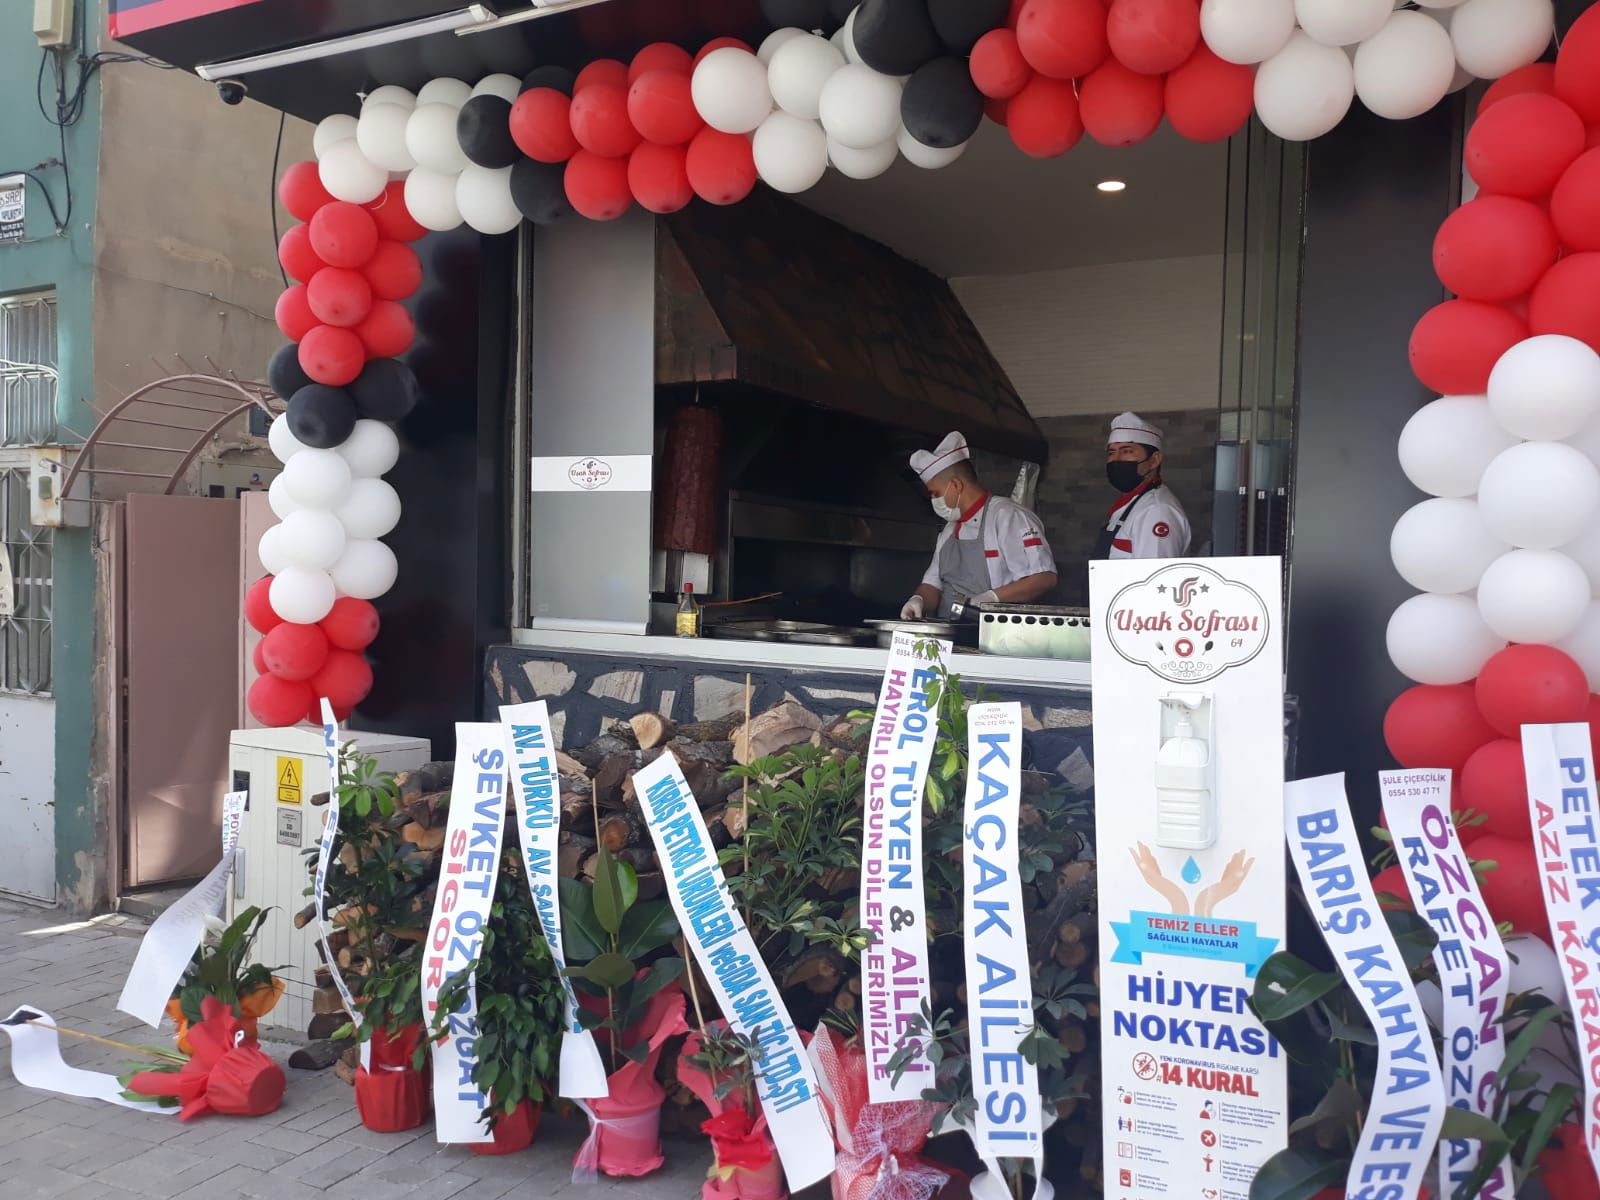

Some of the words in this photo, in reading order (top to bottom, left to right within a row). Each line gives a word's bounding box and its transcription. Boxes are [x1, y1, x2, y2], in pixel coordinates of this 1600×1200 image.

[1113, 609, 1172, 635] Uşak
[1178, 609, 1259, 638] Sofrası
[1230, 638, 1243, 648] 64
[511, 724, 546, 755] AV.
[873, 669, 907, 756] HAYIRLI
[898, 668, 937, 750] EROL
[518, 757, 559, 830] TÜRKÜ
[645, 773, 693, 827] KİRİŞ
[867, 764, 886, 849] OLSUN
[1383, 776, 1402, 785] ŞULE
[1404, 774, 1447, 785] ÇİÇEKÇİLİK
[1388, 788, 1407, 798] 0554
[1408, 788, 1421, 797] 530
[1422, 786, 1431, 796] 47
[1432, 786, 1441, 795] 71
[462, 748, 505, 899] ŞEVKET
[659, 812, 707, 879] PETROL
[888, 761, 917, 889] TÜYEN
[965, 733, 1013, 939] KAÇAK
[1535, 799, 1571, 905] AZİZ
[1559, 757, 1600, 910] PETEK
[527, 847, 551, 878] AV.
[1296, 808, 1372, 935] BARIŞ
[677, 864, 746, 950] ÜRÜNLERİ
[889, 905, 915, 933] &
[1146, 916, 1190, 932] TEMİZ
[1194, 921, 1239, 938] ELLER
[1147, 932, 1190, 945] SAĞLIKLI
[1191, 936, 1239, 949] HAYATLAR
[1401, 836, 1474, 1006] RAFET
[1420, 804, 1502, 1045] ÖZCAN
[866, 859, 892, 1081] DİLEKLERİMİZLE
[732, 989, 778, 1029] SAN
[1113, 1009, 1279, 1059] NOKTASI
[1343, 943, 1432, 1096] KAHYA
[976, 953, 1038, 1141] AİLESİ
[1159, 1062, 1183, 1085] 14
[1186, 1066, 1260, 1098] KURAL
[1369, 1104, 1431, 1152] VE
